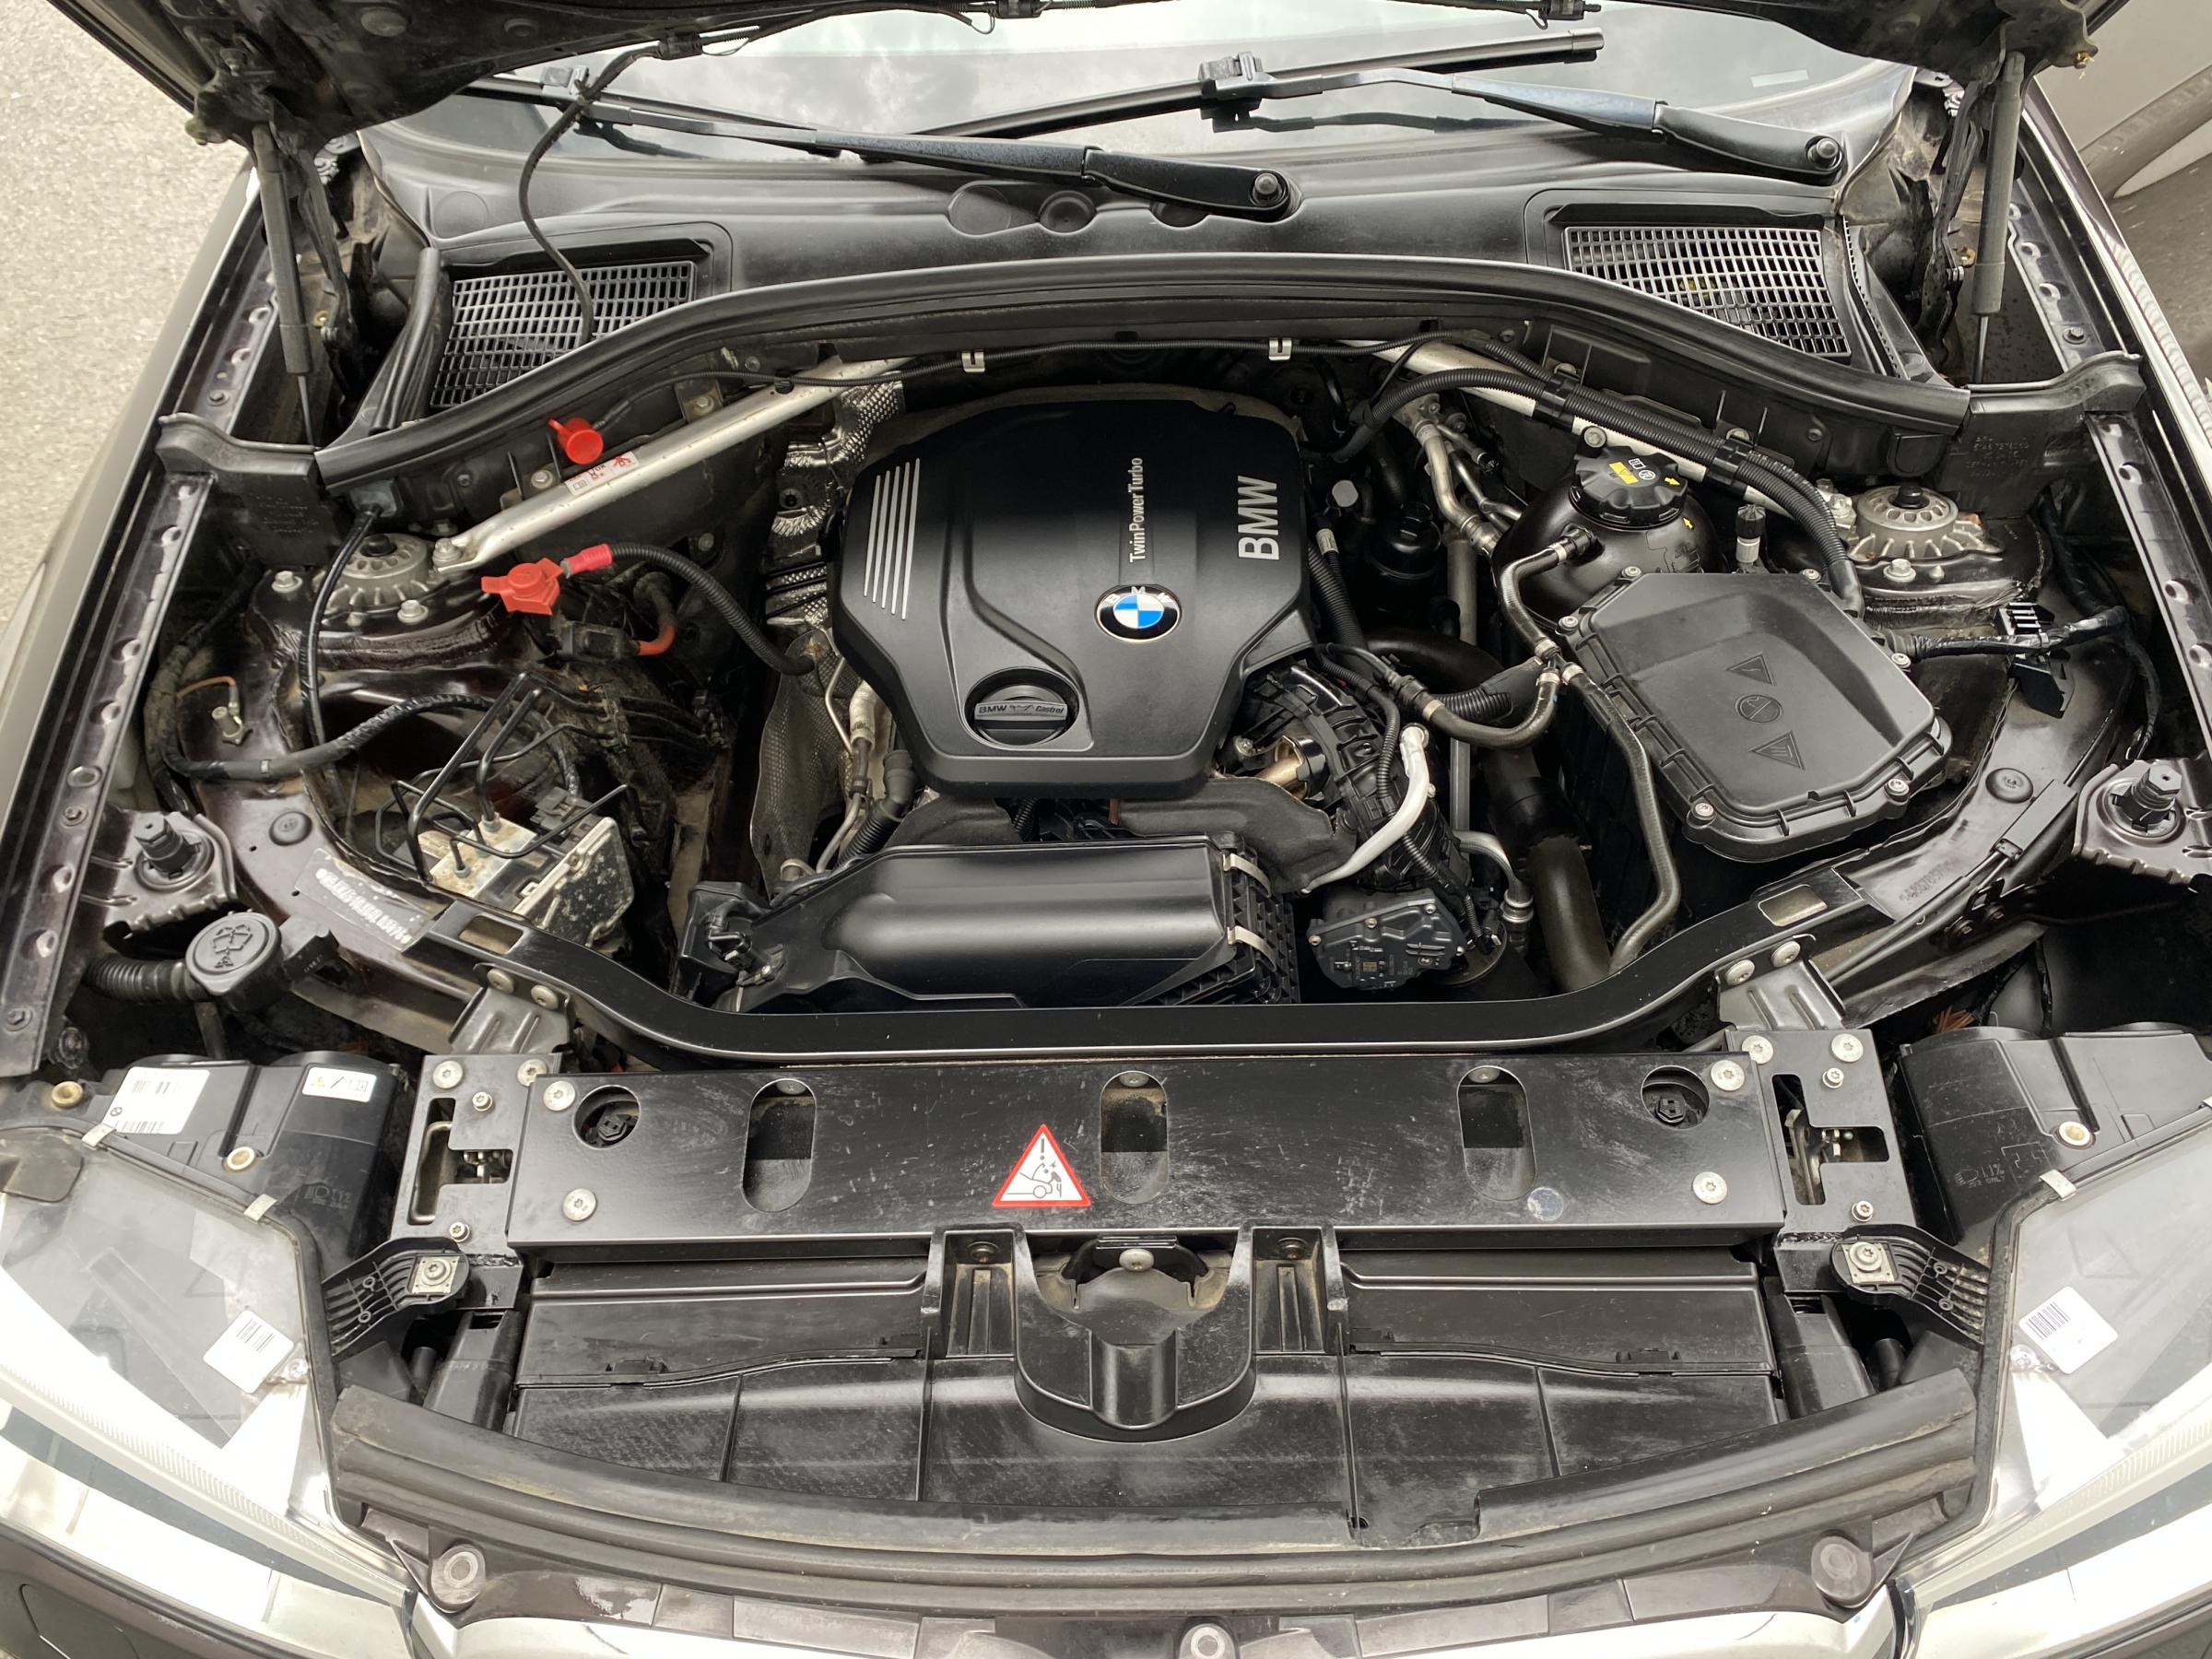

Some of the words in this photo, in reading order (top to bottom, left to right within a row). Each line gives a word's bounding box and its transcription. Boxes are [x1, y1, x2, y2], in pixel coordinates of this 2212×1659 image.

[1127, 457, 1144, 493] Turbo
[1129, 493, 1146, 563] TwinPower
[1237, 475, 1280, 560] BMW
[1102, 585, 1174, 605] BMW
[979, 704, 1007, 713] BMW
[1035, 705, 1065, 713] Castrol
